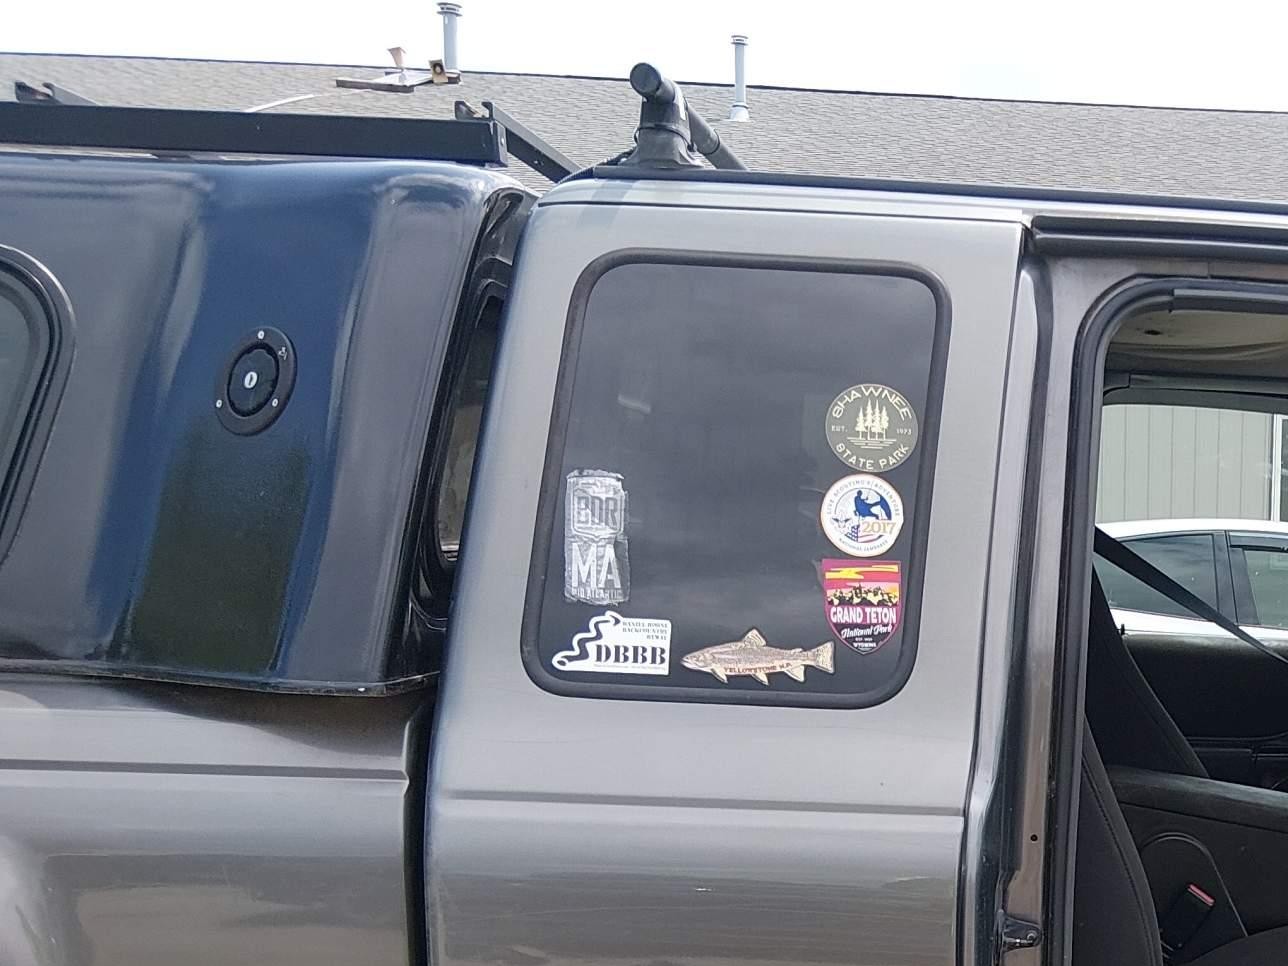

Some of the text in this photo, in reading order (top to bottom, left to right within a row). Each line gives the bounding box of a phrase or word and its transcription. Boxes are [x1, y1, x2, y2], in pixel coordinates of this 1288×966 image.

[832, 385, 912, 421] SHAWNEE
[836, 442, 909, 470] STATE PARK
[862, 521, 897, 535] 2017
[571, 542, 621, 589] MA
[830, 607, 897, 624] GRAND TETON
[595, 644, 666, 665] DBBB
